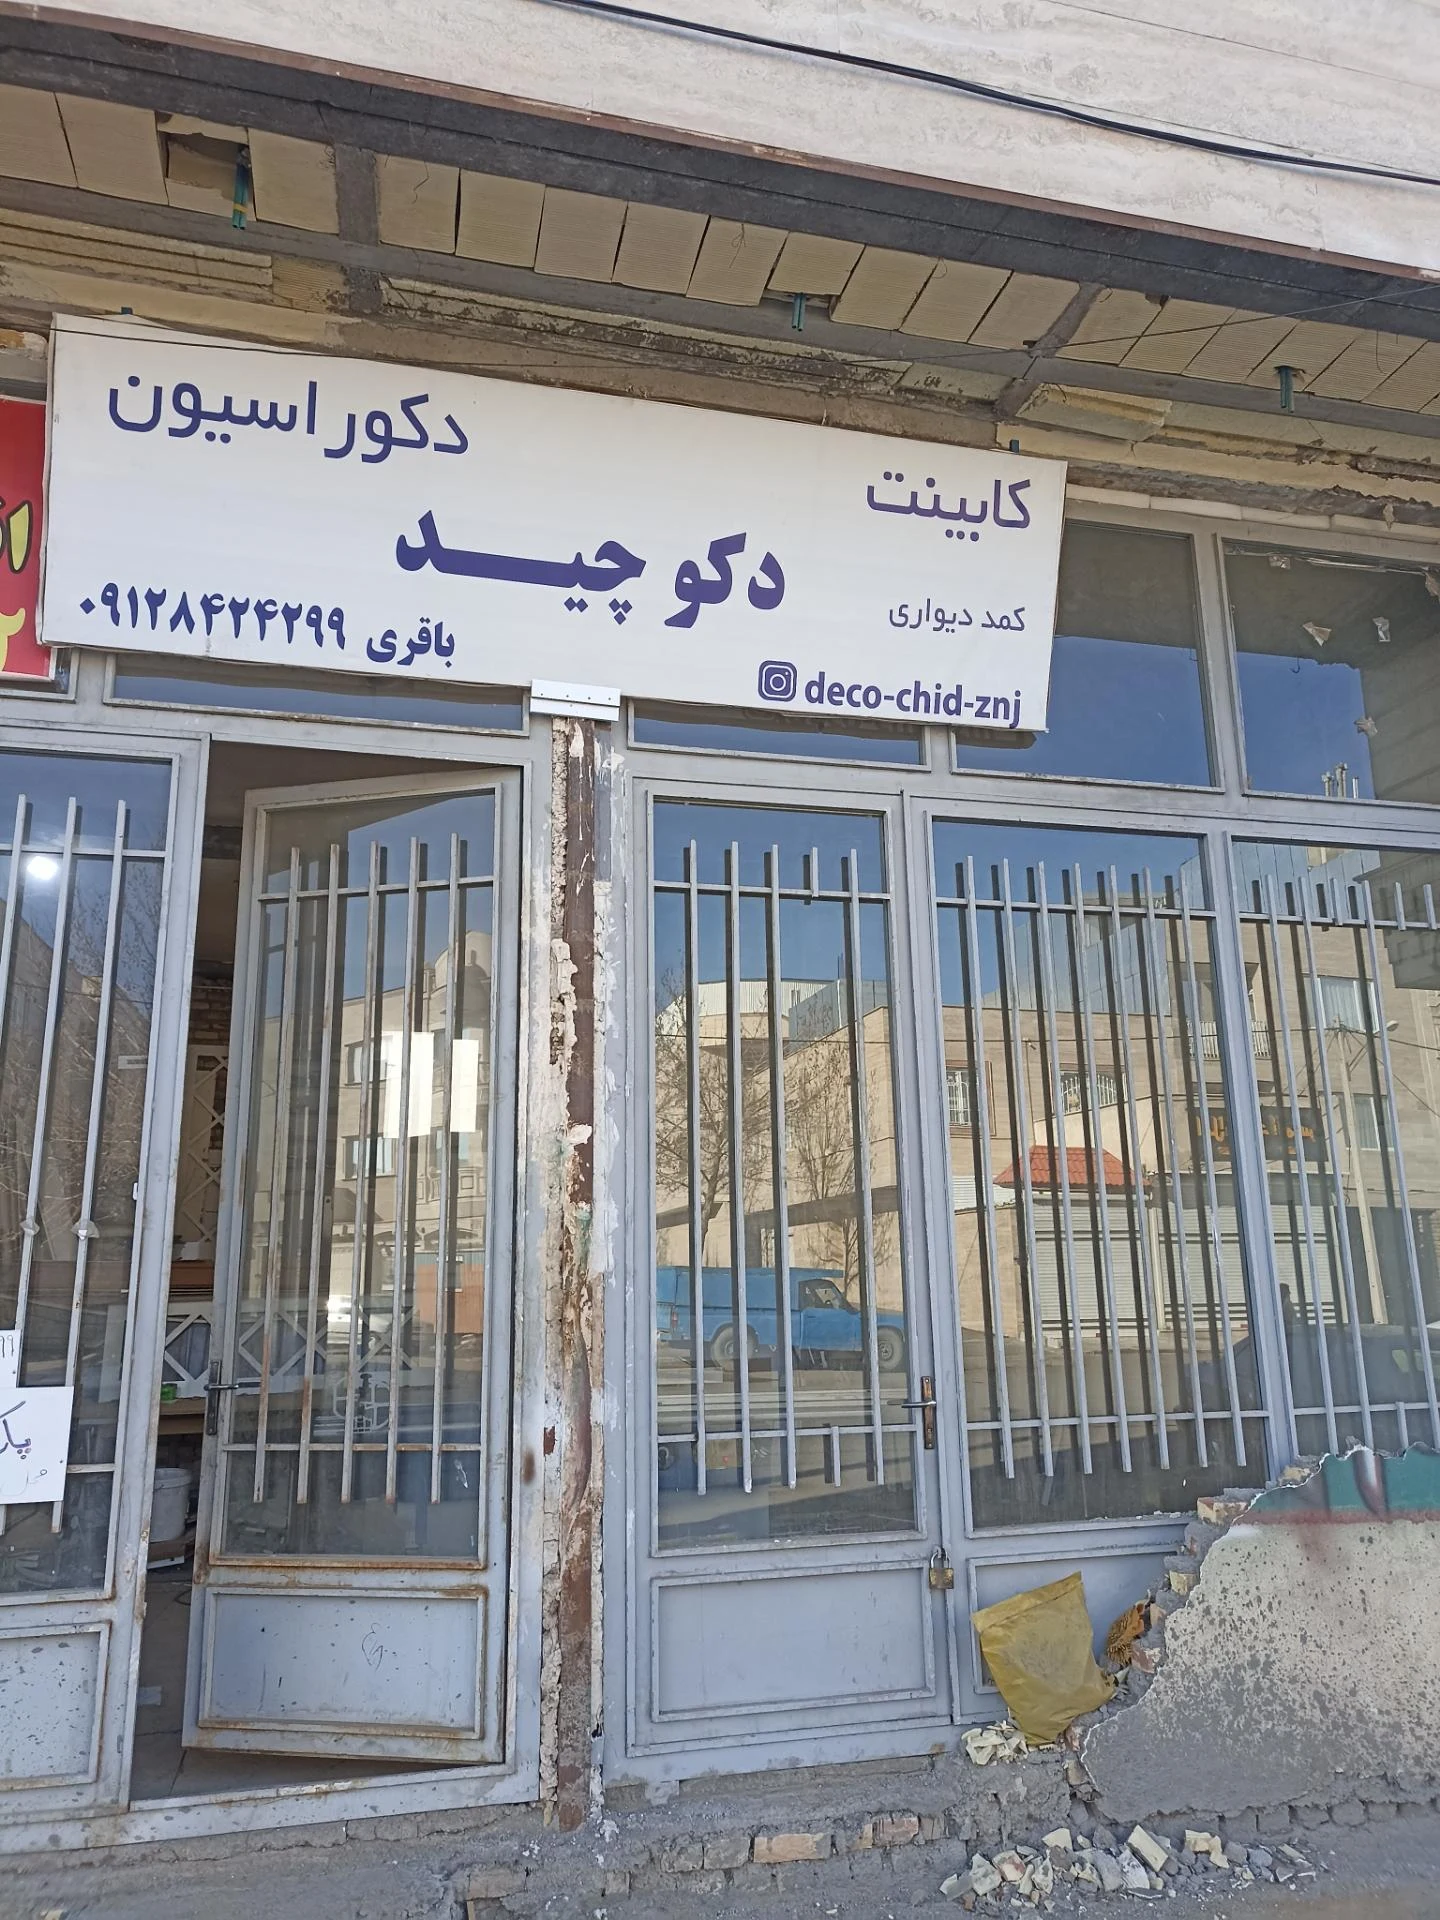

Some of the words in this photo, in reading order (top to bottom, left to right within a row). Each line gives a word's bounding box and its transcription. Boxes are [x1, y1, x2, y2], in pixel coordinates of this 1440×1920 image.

[866, 471, 1030, 543] کابینت
[395, 511, 647, 626] چید
[663, 532, 785, 629] دکو
[79, 582, 346, 650] ۰۹۱۲۸۴۲۴۲۹۹
[366, 616, 455, 669] باقری
[888, 597, 974, 634] دیواری
[980, 606, 1026, 634] کمد
[804, 671, 1023, 730] deco-chid-znj
